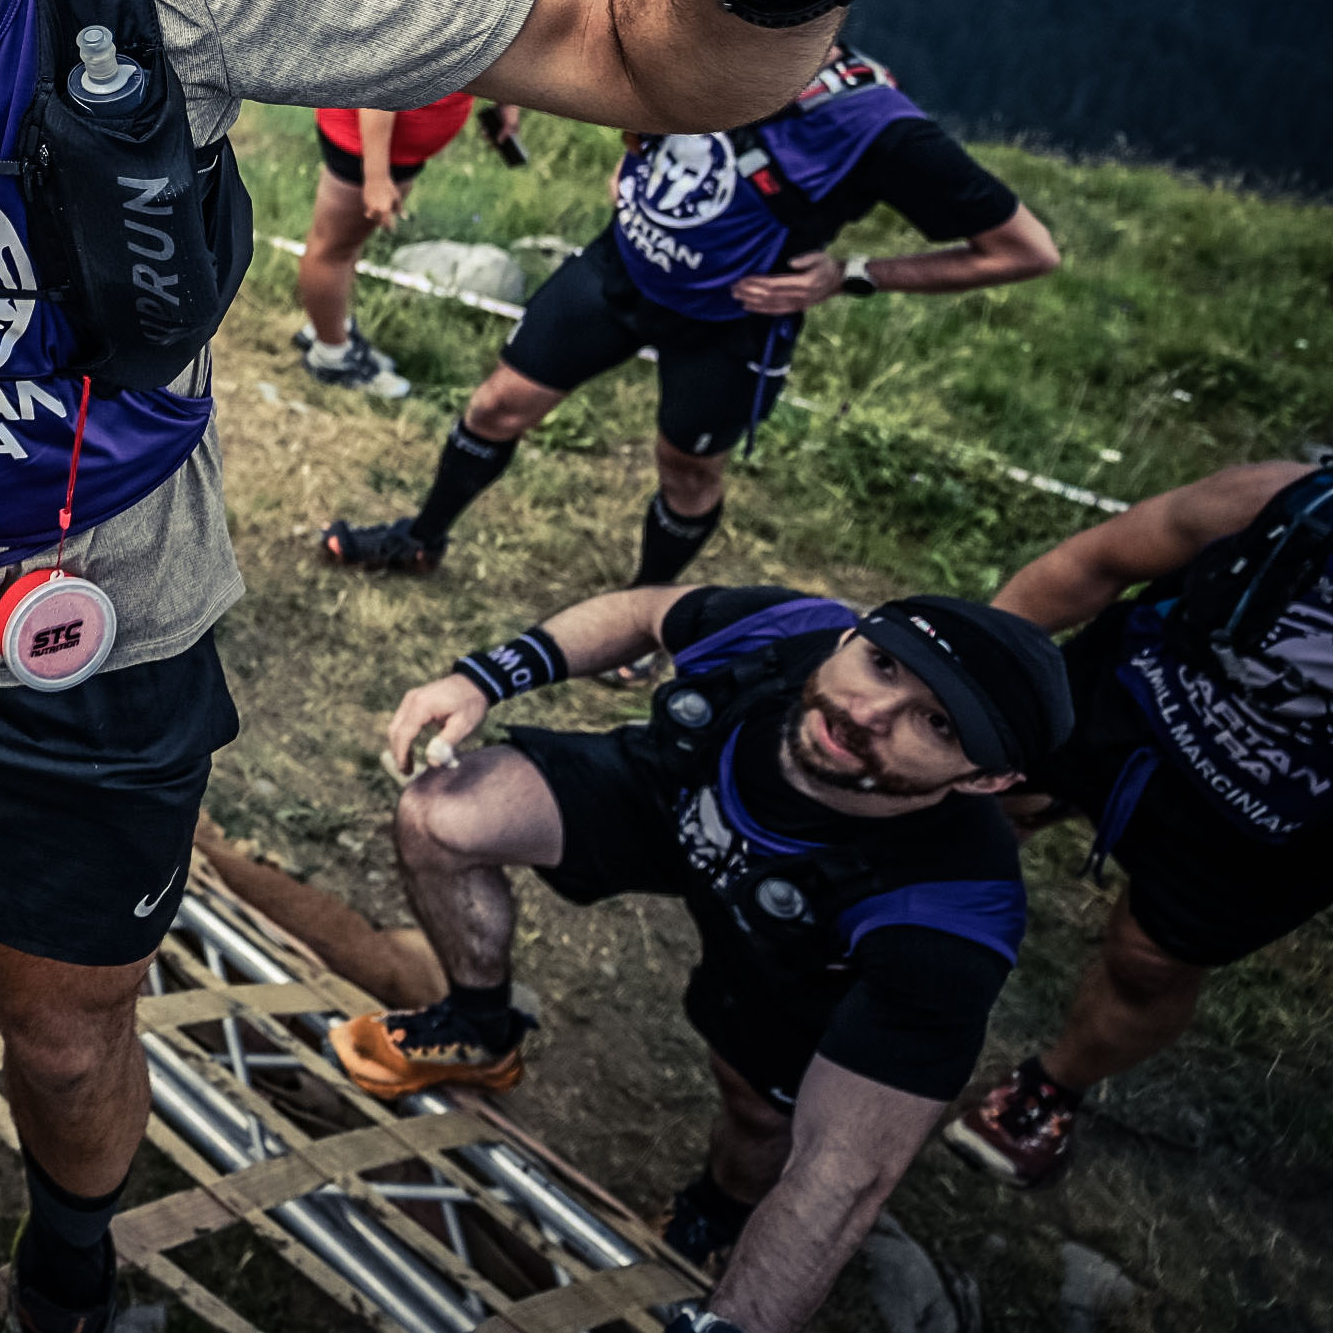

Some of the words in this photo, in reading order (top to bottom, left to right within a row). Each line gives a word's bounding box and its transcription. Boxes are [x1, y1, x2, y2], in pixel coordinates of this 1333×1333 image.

[32, 618, 83, 650] STC
[1131, 649, 1180, 725] AMILL
[1196, 673, 1331, 796] ARTAN
